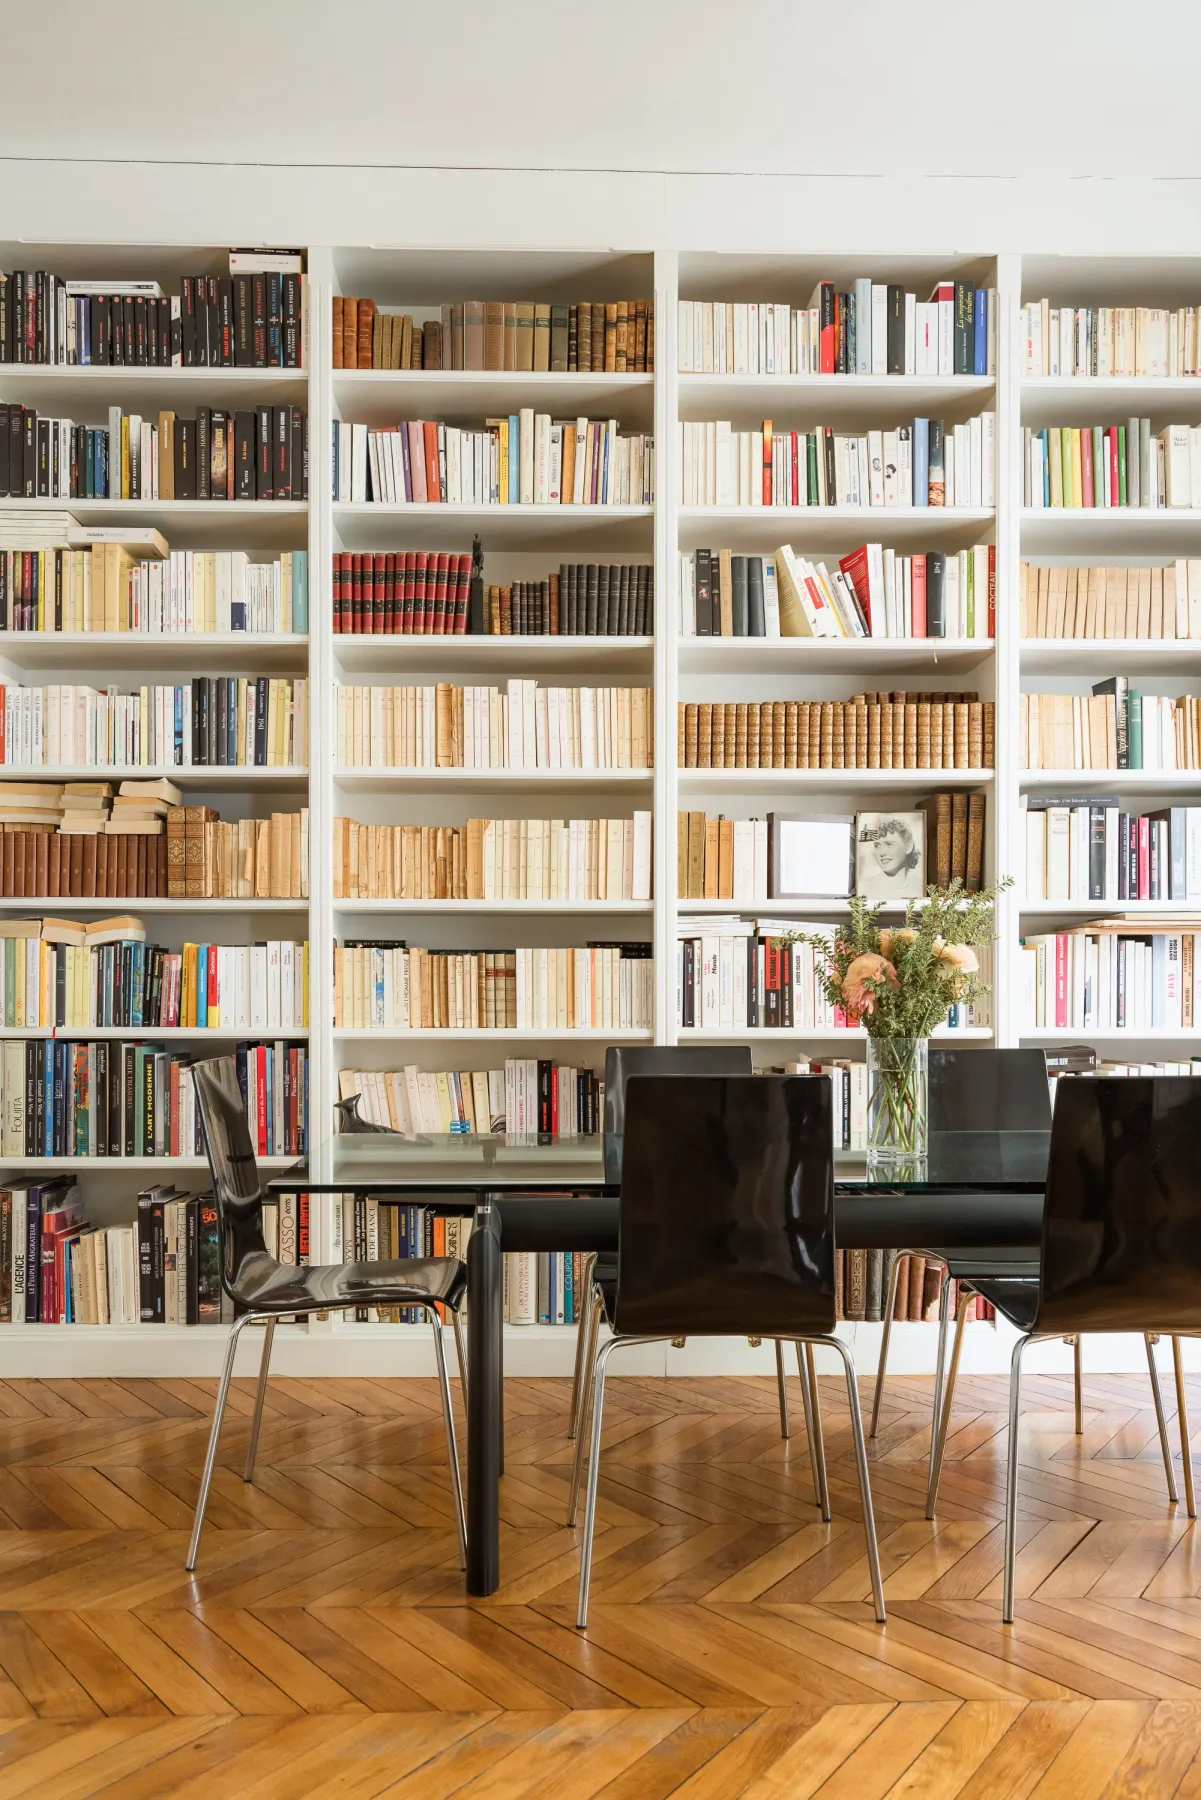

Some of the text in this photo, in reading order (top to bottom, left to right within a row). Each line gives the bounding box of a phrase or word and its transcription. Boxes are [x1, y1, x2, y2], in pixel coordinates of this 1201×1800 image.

[957, 285, 967, 319] conspiration
[257, 718, 265, 730] 1941
[11, 1096, 23, 1133] FOUJITA
[281, 1216, 294, 1265] CASSO
[300, 1193, 309, 1266] WILLIAM KLEIN PA
[368, 1238, 375, 1250] DE
[447, 1230, 457, 1258] RICAINE
[177, 1206, 187, 1303] LE PALAIS BULLES
[564, 1252, 573, 1291] COUPOL
[14, 1255, 24, 1294] L'AGENCE
